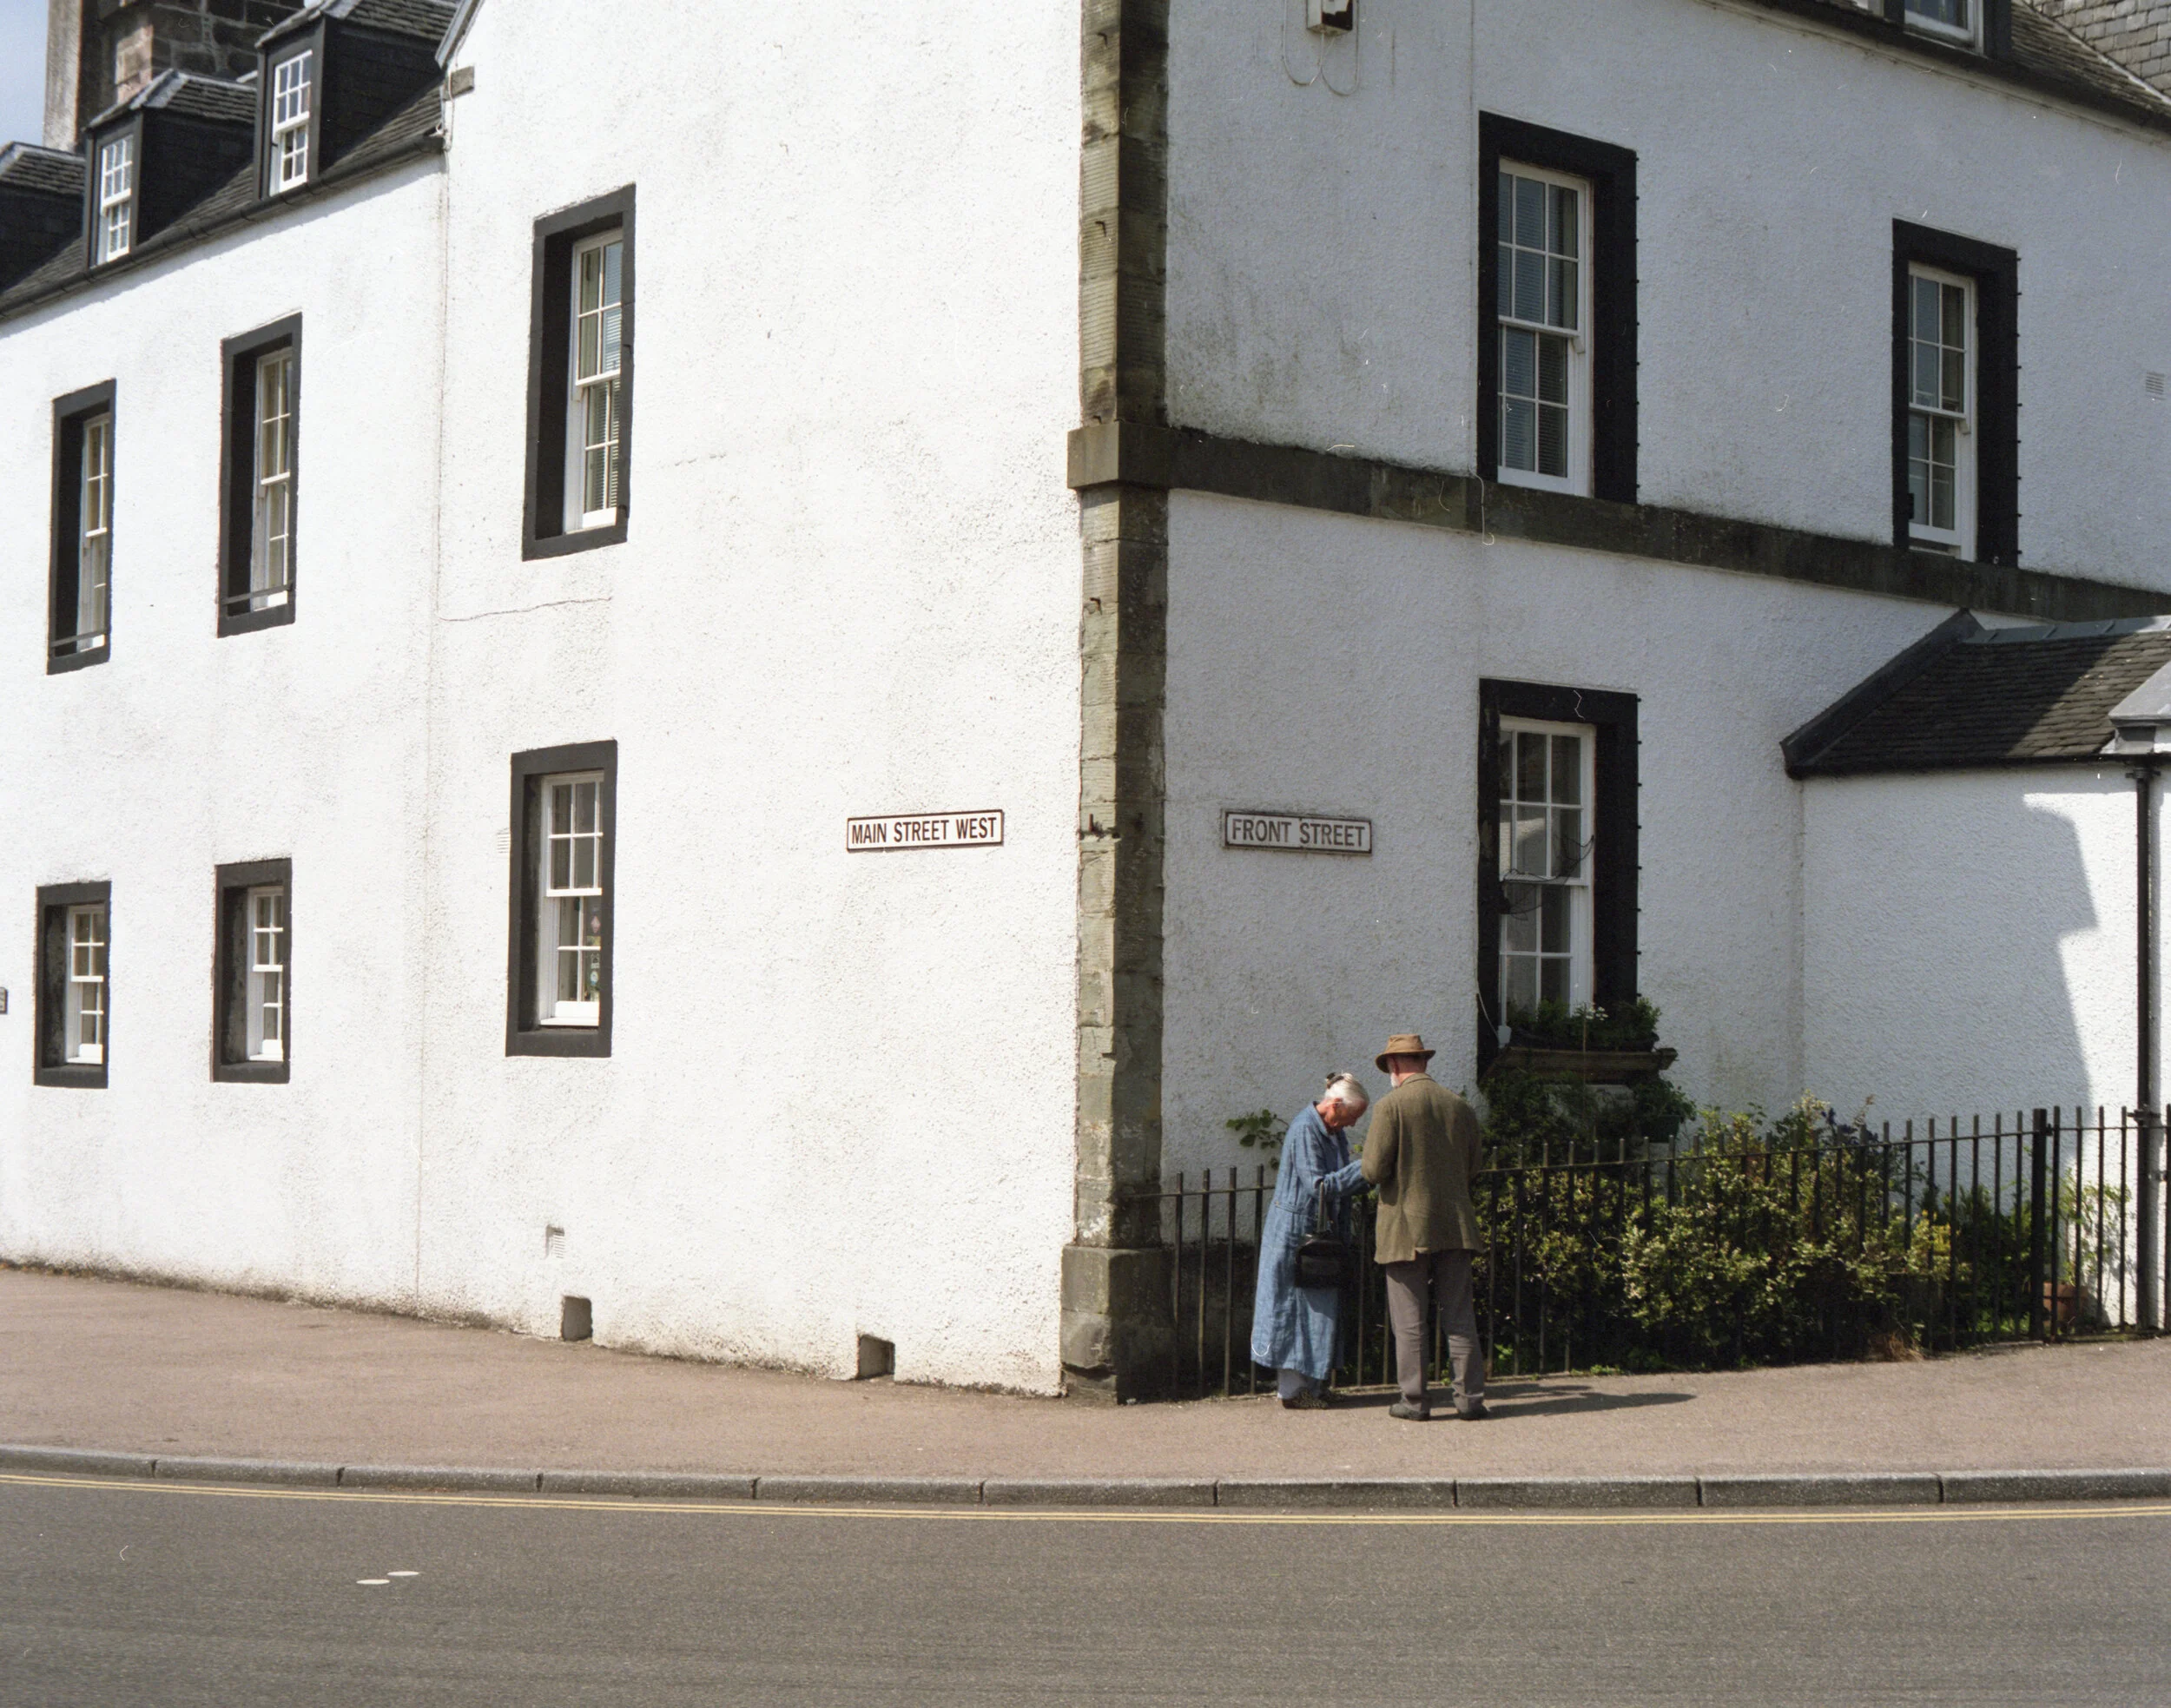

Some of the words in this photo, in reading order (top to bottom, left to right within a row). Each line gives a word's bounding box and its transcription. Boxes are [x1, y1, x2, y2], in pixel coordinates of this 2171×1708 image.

[852, 823, 887, 844] MAIN
[894, 820, 949, 842] STREET
[956, 817, 997, 839] WEST
[1232, 819, 1291, 842] FRONT
[1299, 823, 1365, 847] STREET
